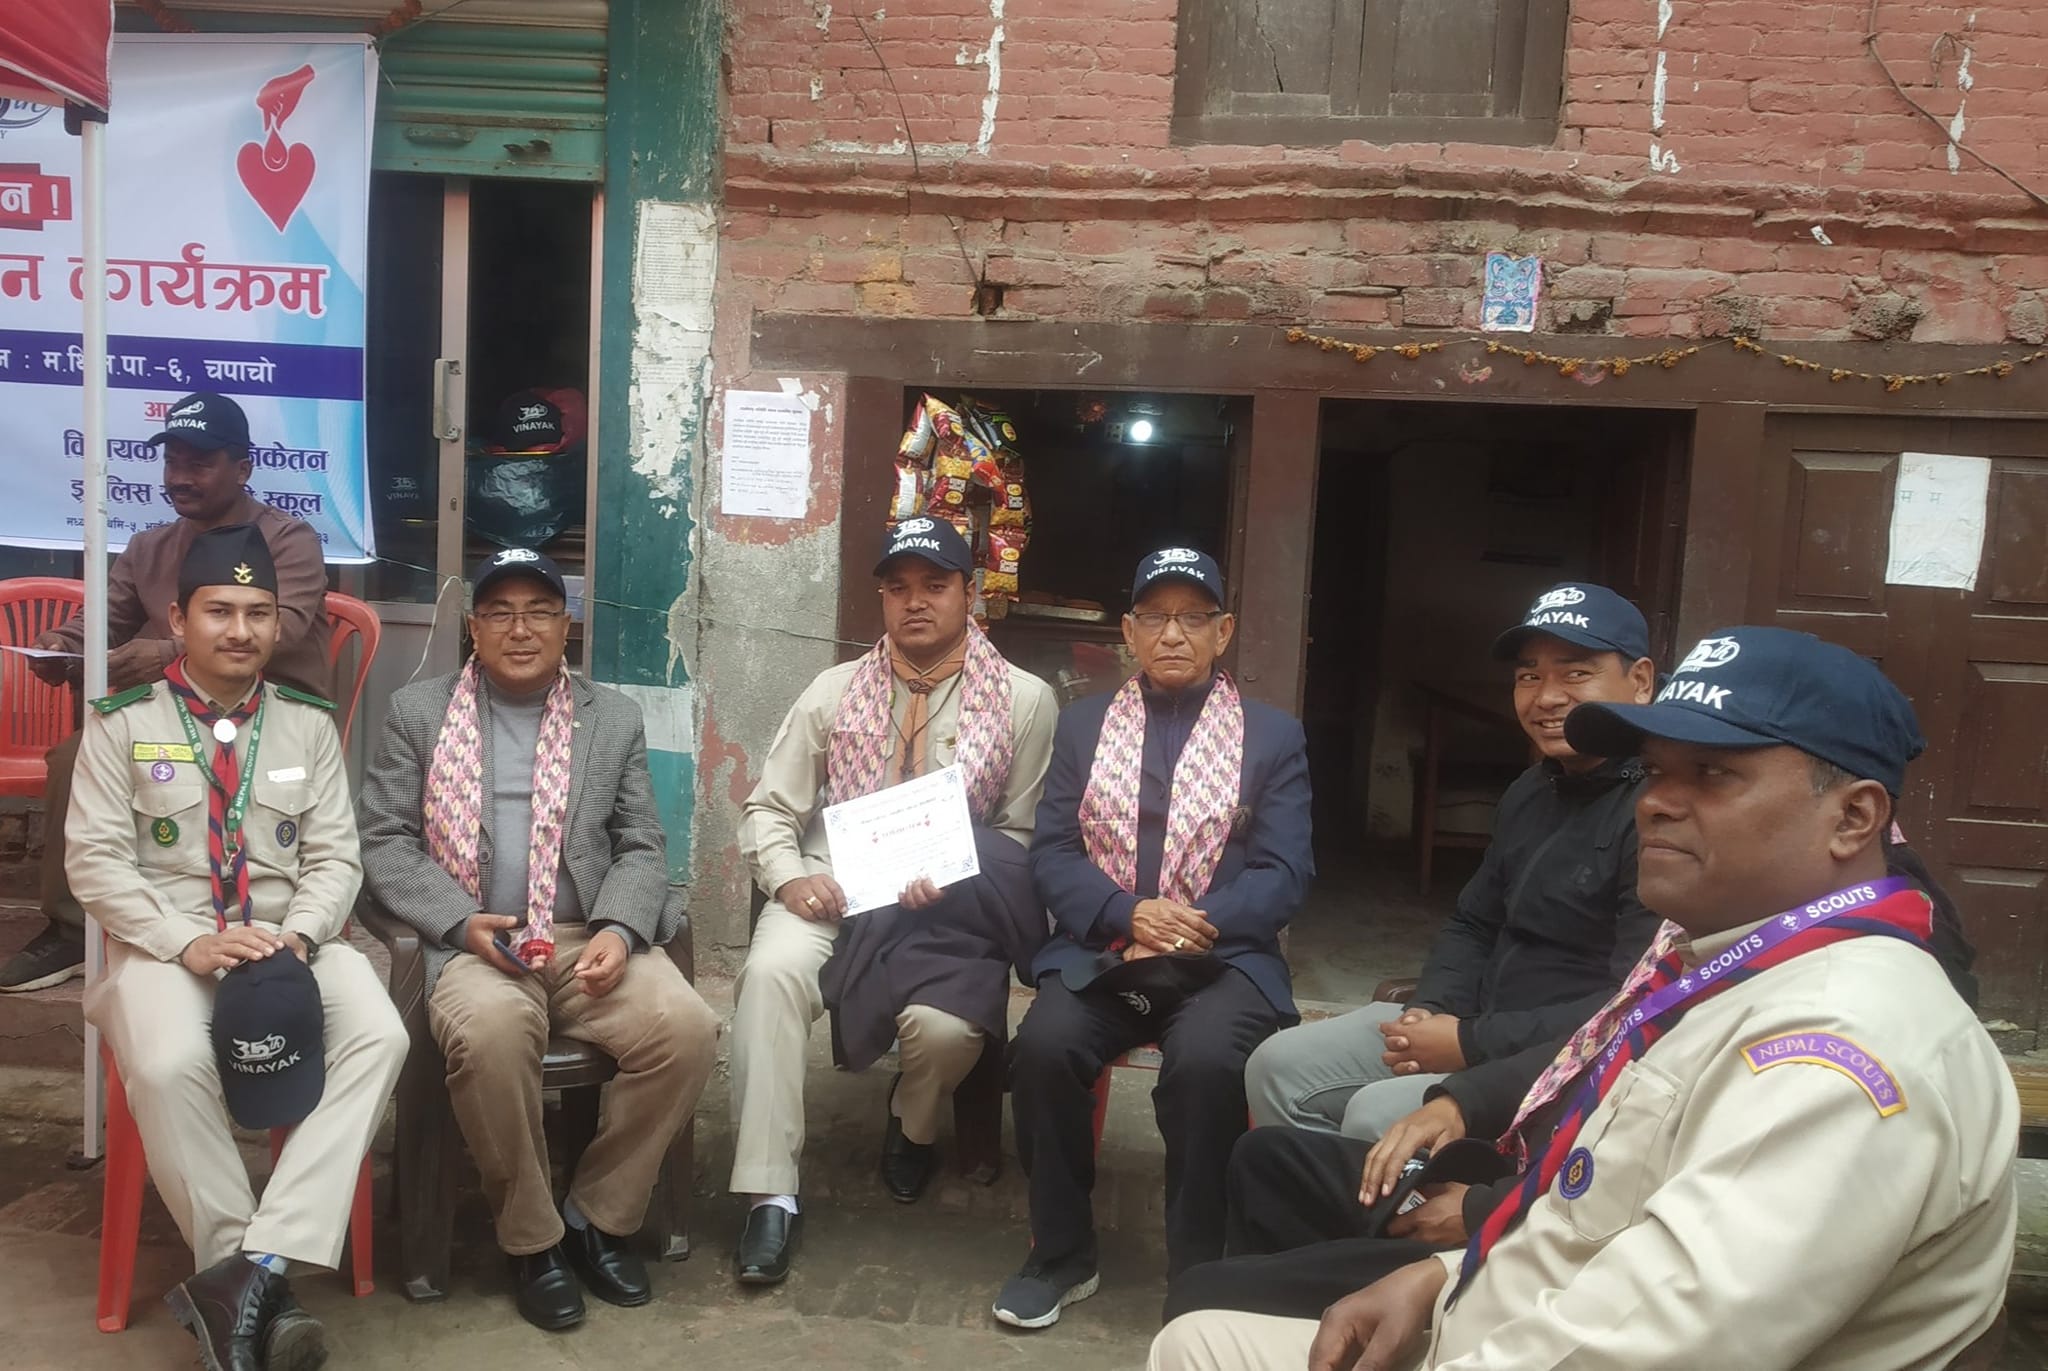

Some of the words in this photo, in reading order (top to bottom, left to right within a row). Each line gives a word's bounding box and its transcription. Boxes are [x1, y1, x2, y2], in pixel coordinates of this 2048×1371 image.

[203, 356, 277, 384] चपाचो
[512, 421, 556, 433] VINAYAK
[235, 780, 249, 808] NEPAL
[1806, 886, 1877, 920] SCOUTS
[1700, 934, 1764, 981] SCOUTS
[1607, 1008, 1644, 1062] SCOUTS
[228, 1050, 302, 1074] VINAYAK
[1759, 1038, 1821, 1060] NEPAL
[1824, 1040, 1893, 1100] SCOUTS
